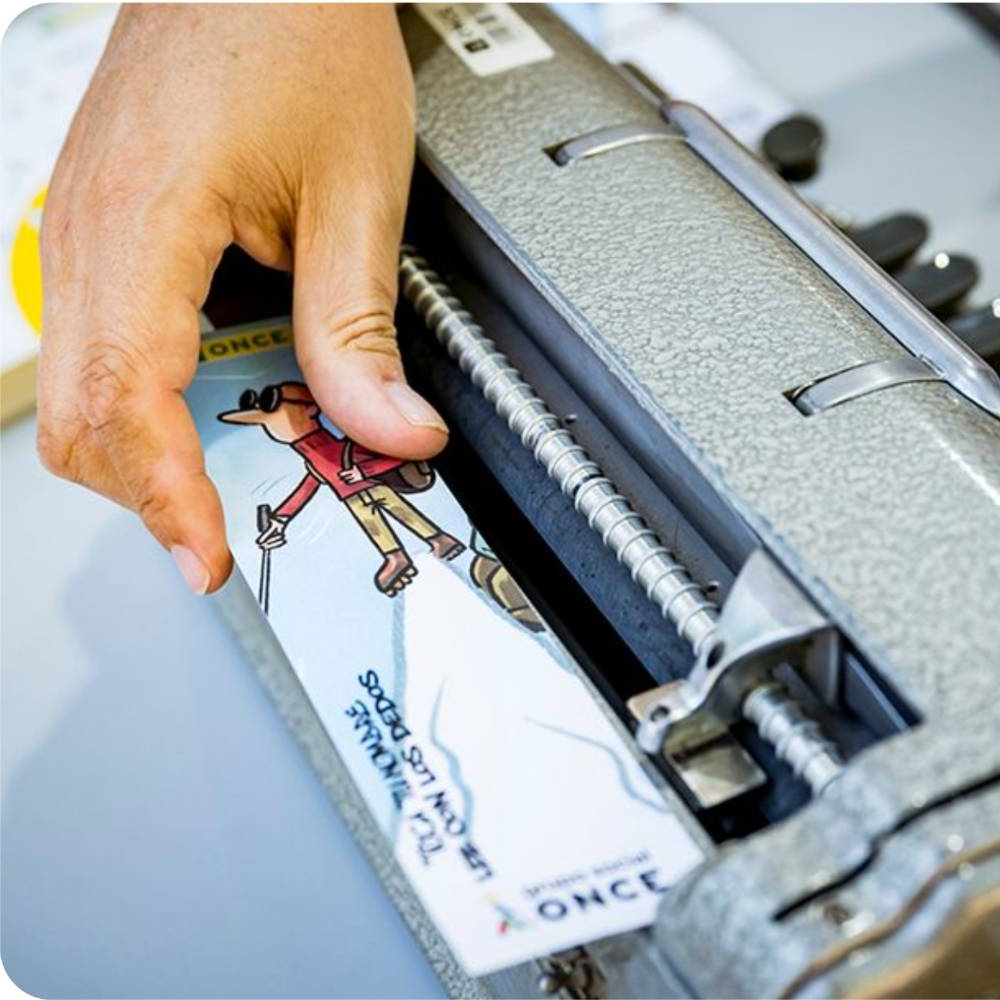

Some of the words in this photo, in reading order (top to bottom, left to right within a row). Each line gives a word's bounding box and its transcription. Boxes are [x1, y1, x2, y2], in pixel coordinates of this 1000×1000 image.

[210, 328, 289, 356] ONCE
[357, 669, 413, 742] DEDOS
[401, 745, 437, 792] LOS
[537, 868, 672, 922] ONCE
